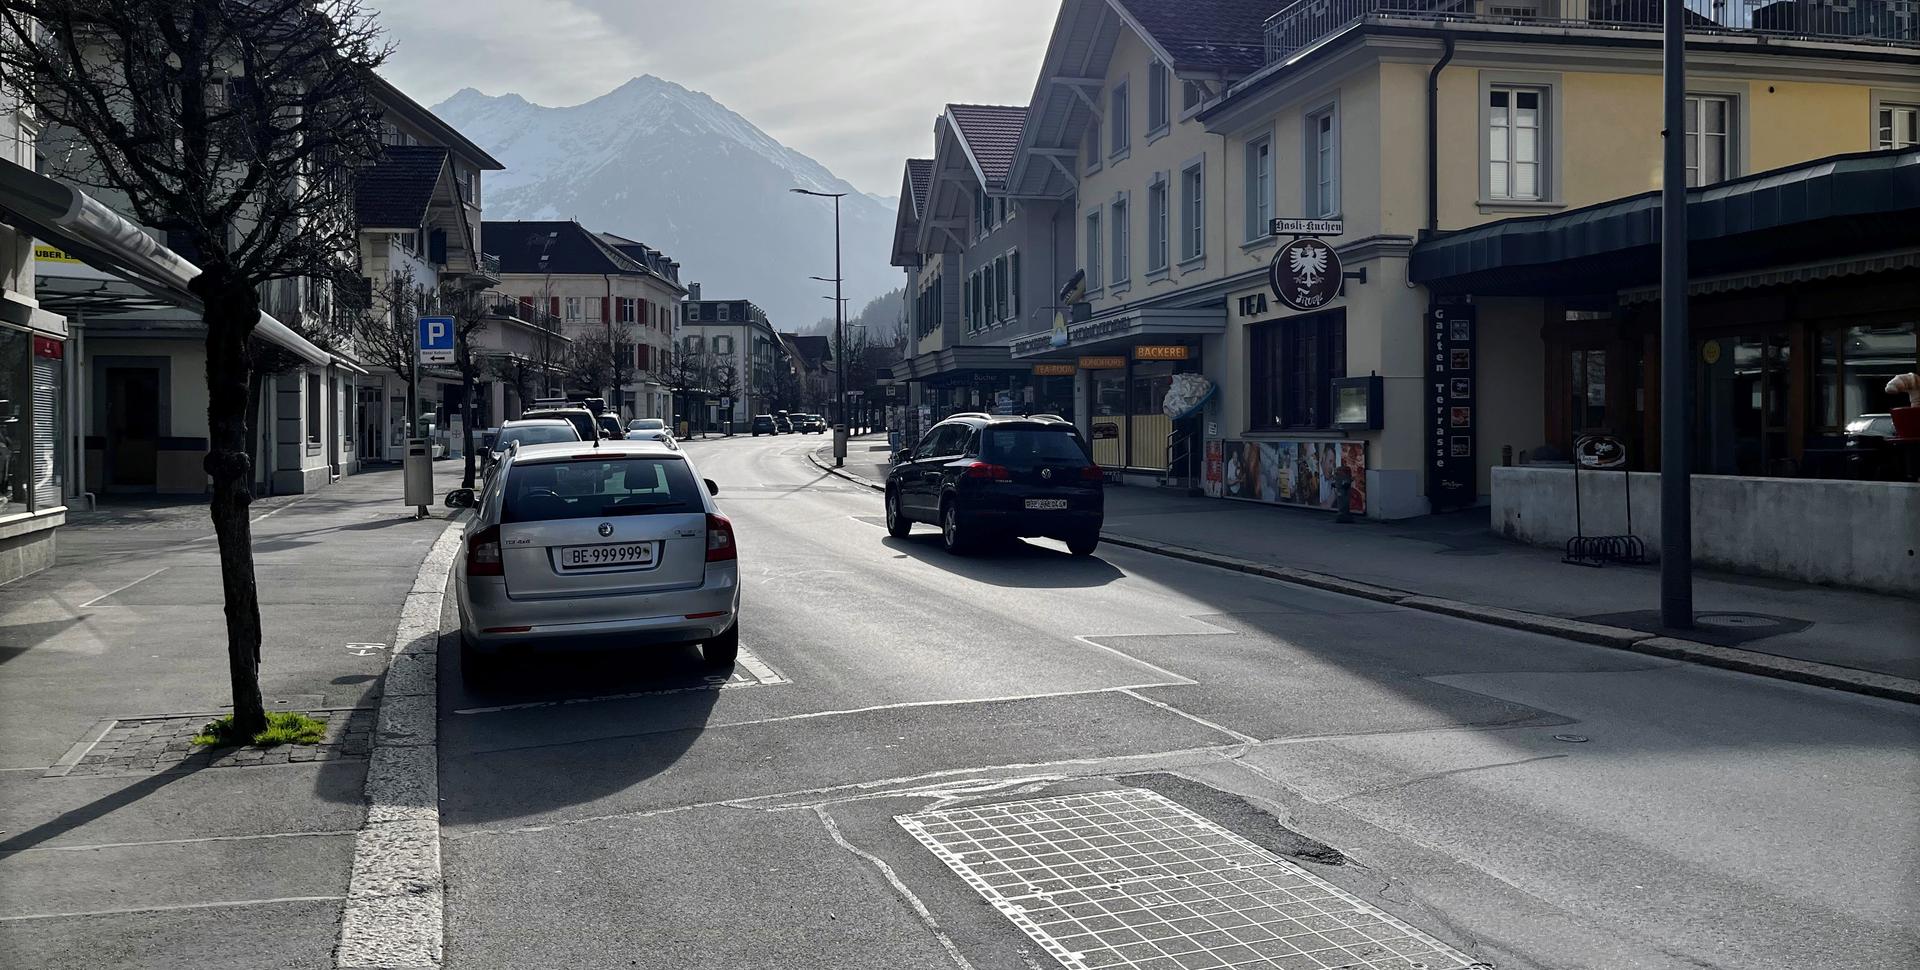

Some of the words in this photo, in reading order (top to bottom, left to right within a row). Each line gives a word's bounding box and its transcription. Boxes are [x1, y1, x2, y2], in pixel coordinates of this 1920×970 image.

[1238, 293, 1268, 316] TEA
[428, 322, 445, 345] P
[1434, 308, 1444, 372] Garten
[1434, 383, 1445, 467] Terrasse
